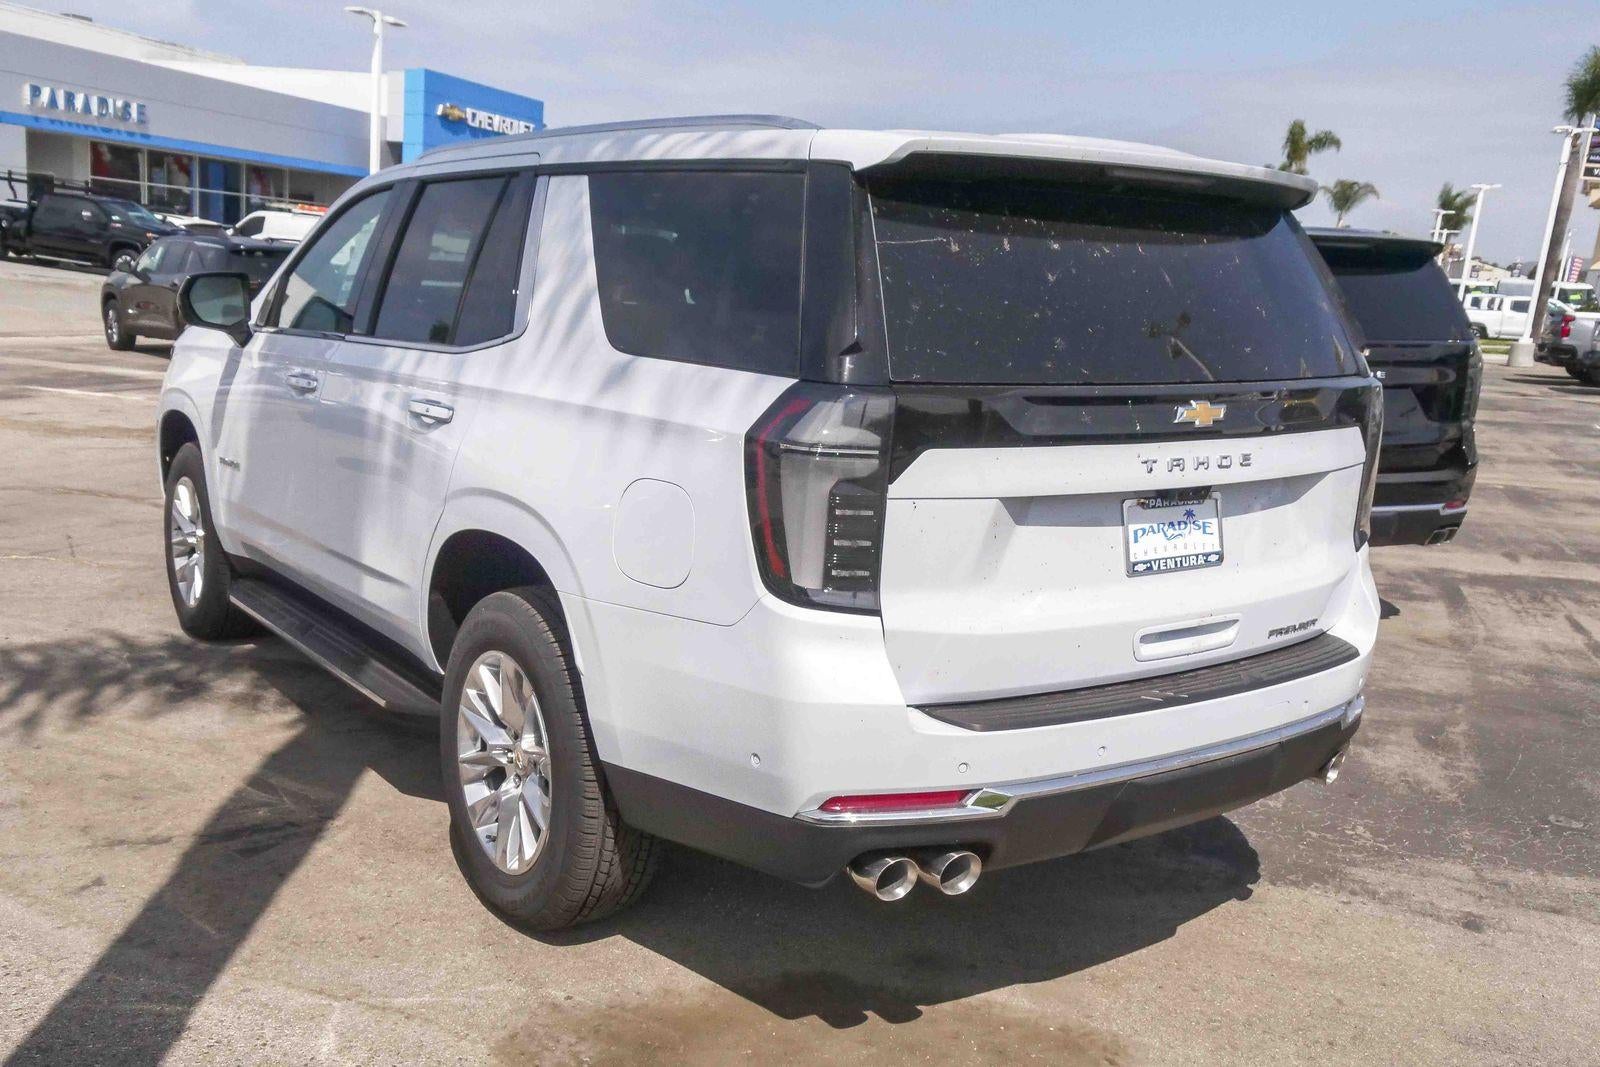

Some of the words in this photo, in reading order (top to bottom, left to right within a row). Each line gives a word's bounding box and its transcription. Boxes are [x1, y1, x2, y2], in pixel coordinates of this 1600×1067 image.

[24, 82, 147, 125] PARADISE
[466, 107, 536, 135] CHEVROLET
[1141, 453, 1252, 474] TAHOE
[1133, 513, 1214, 544] PARADISE
[1151, 554, 1205, 571] VENTURA
